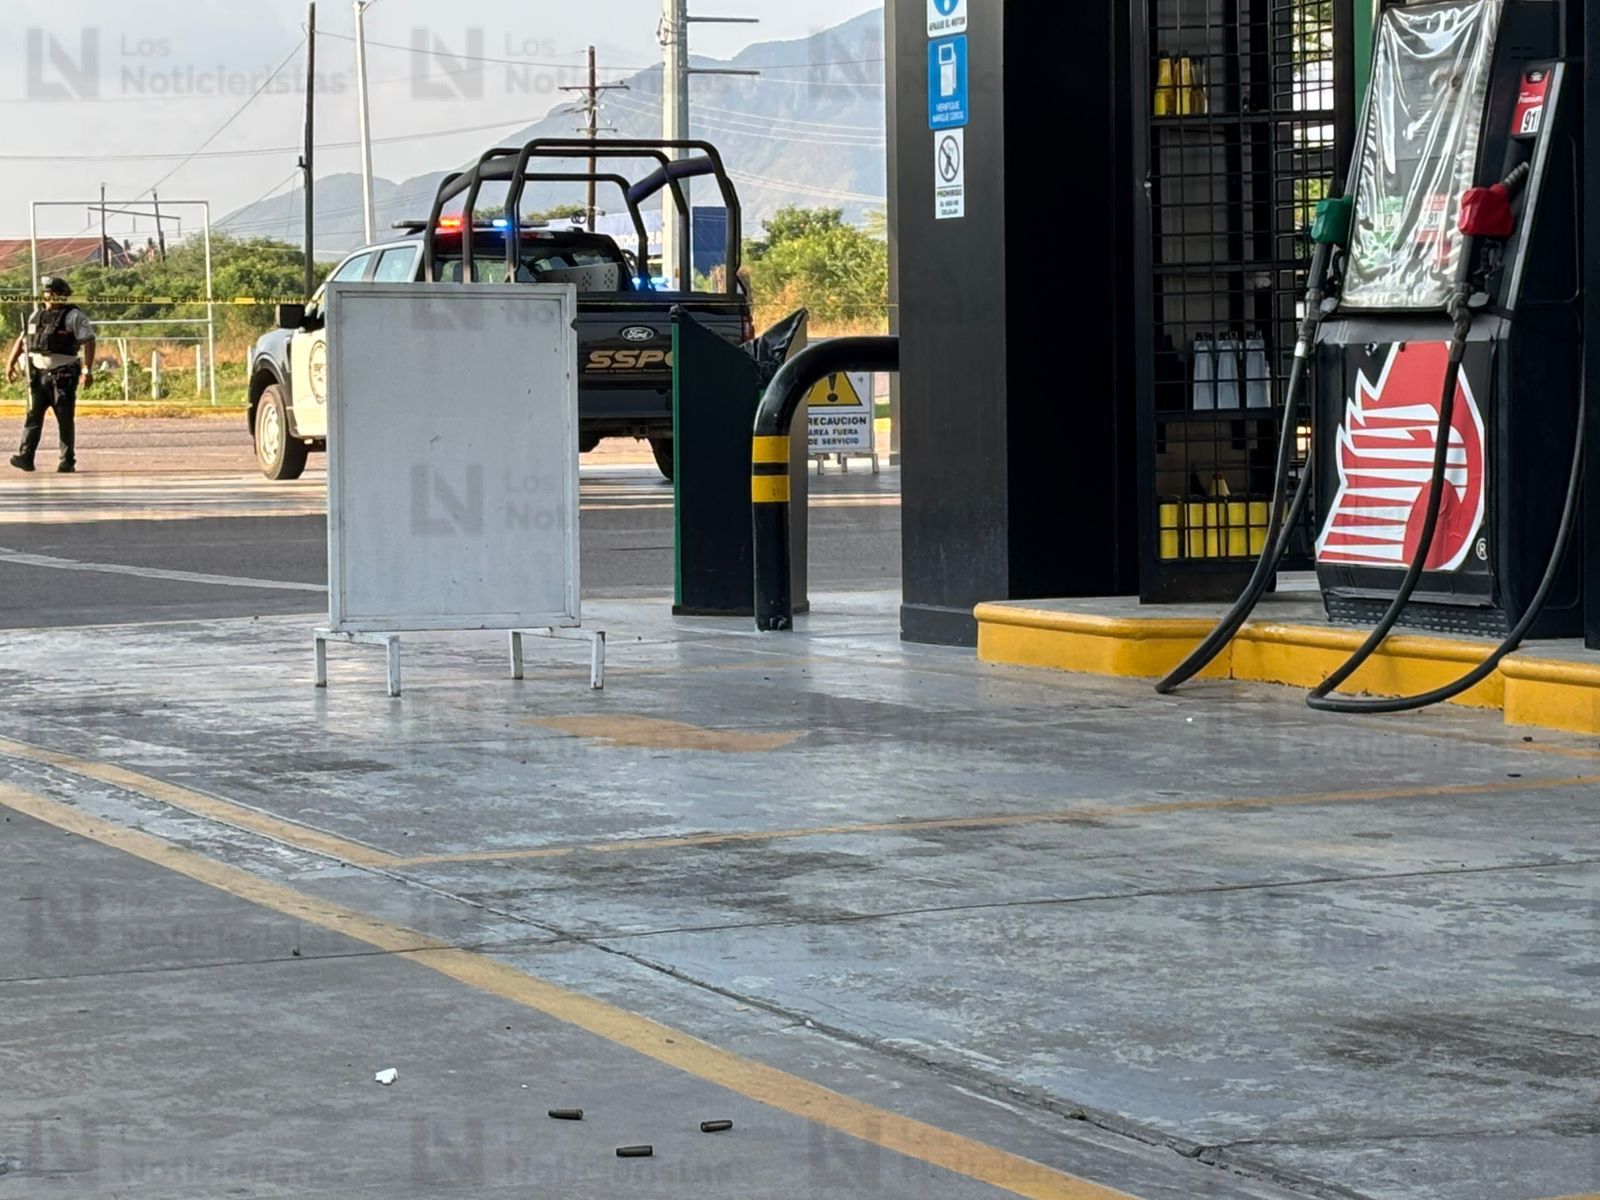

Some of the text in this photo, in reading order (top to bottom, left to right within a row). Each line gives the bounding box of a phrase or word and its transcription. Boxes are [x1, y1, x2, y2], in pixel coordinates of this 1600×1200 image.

[1523, 110, 1537, 131] 91
[626, 328, 650, 341] Ford
[808, 416, 867, 426] RECAUCION
[832, 428, 859, 436] FUERA
[822, 437, 860, 446] SERVICIO
